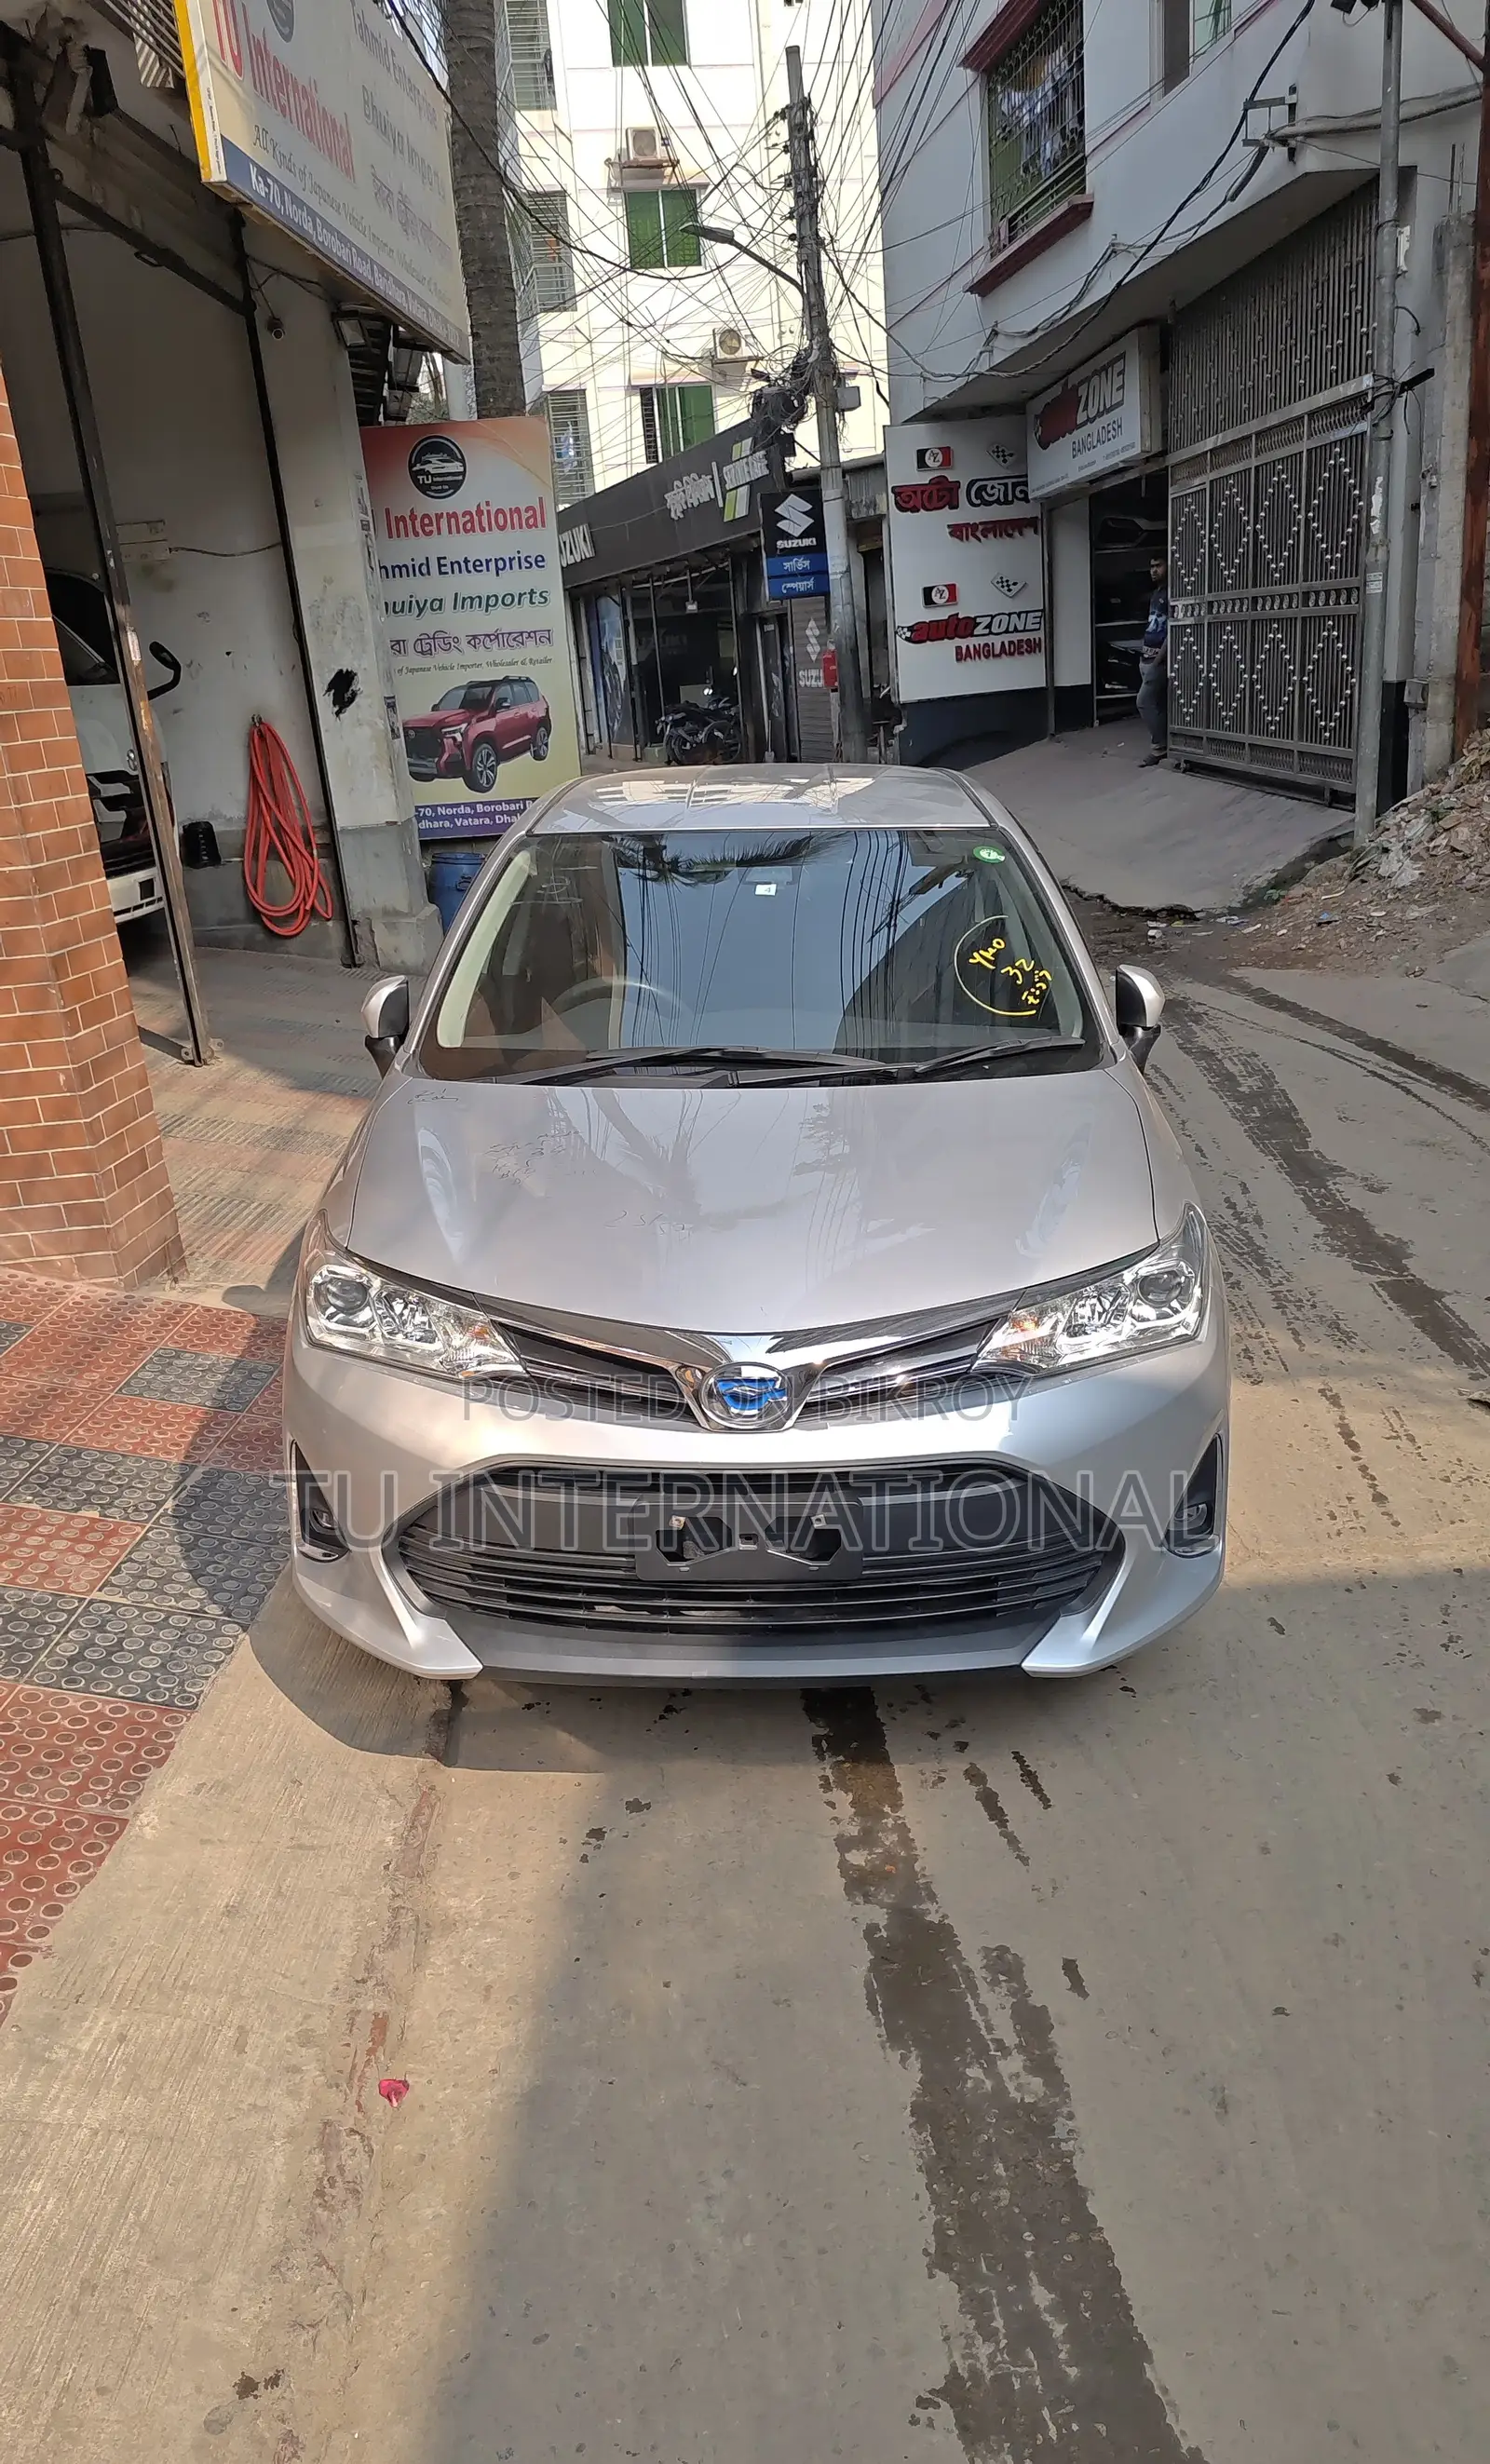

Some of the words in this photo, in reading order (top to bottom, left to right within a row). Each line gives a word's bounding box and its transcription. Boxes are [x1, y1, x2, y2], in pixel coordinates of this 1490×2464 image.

[241, 2, 356, 184] International
[362, 84, 405, 156] Bhuiya
[252, 125, 269, 155] All
[298, 164, 308, 192] of
[249, 161, 284, 215] Ka-70,
[284, 190, 317, 241] Norda,
[317, 218, 352, 266] Borobari
[1072, 417, 1123, 459] BANGLADESH
[417, 475, 432, 484] TU
[892, 475, 961, 513] অটো
[385, 496, 548, 539] International
[776, 537, 817, 549] SUZUKI
[437, 550, 547, 577] Enterprise
[453, 588, 549, 615] Imports
[413, 630, 463, 657] ট্রেডিং
[465, 628, 552, 650] কর্পোরেশন
[955, 637, 1042, 663] BANGLADESH
[437, 805, 475, 816] Norda,
[477, 800, 524, 813] Borobari
[454, 817, 494, 827] Vatara,
